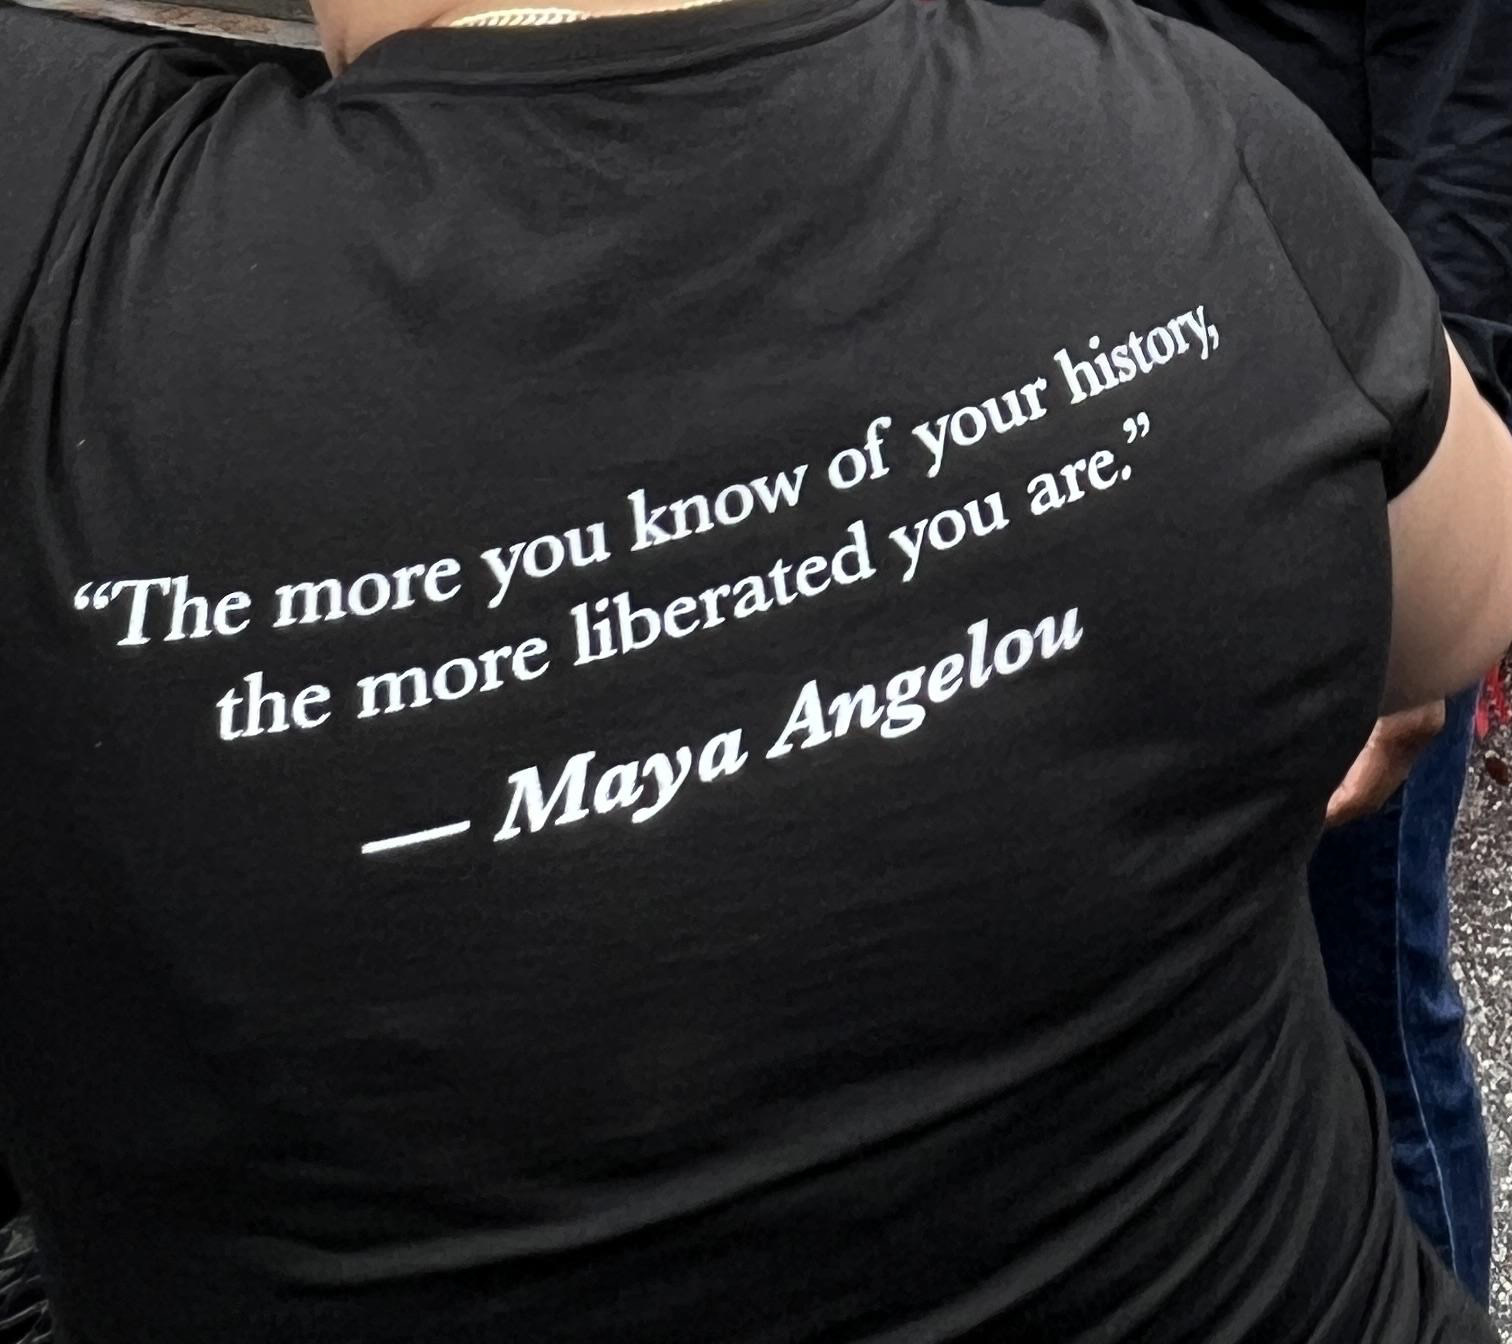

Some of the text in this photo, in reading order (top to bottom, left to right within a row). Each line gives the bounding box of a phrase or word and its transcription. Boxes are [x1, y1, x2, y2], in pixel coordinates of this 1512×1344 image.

[73, 305, 1220, 646] “The more you know of your history,
[215, 670, 332, 741] the
[356, 636, 550, 719] more
[570, 518, 877, 667] liberated
[888, 491, 1010, 583] you
[492, 728, 749, 843] Maya
[765, 607, 1084, 739] Angelou
